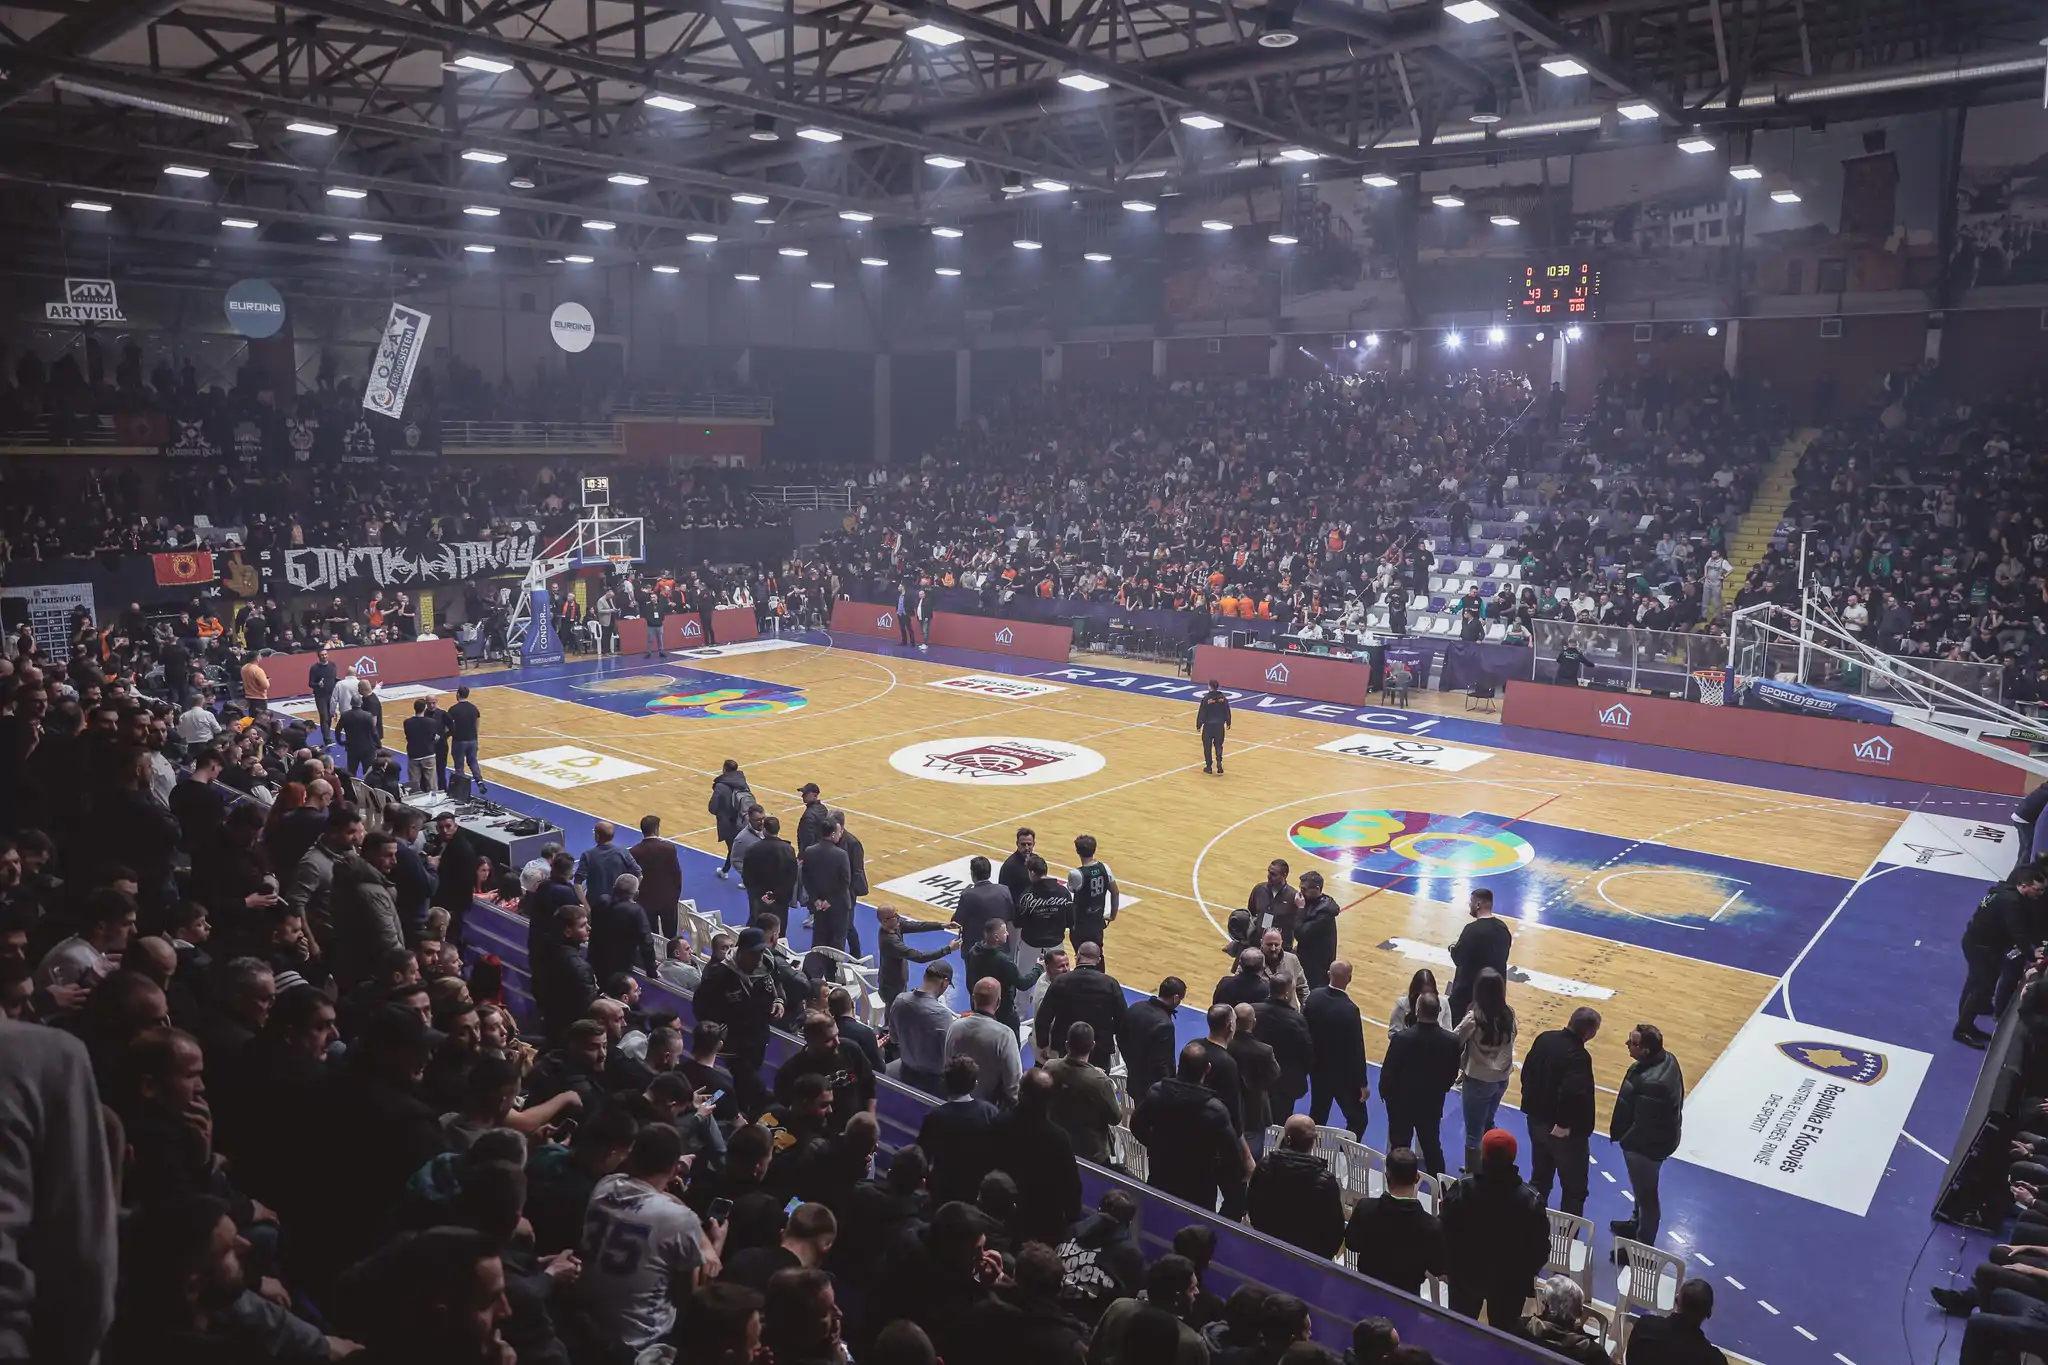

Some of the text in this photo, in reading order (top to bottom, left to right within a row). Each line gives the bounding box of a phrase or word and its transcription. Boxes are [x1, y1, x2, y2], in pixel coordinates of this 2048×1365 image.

[539, 612, 548, 650] CONDOR
[942, 680, 1030, 696] BIGI
[1047, 668, 1440, 731] RAHOVECI
[1759, 685, 1838, 709] SPORTSYSTEM
[1972, 825, 2006, 844] ART
[1791, 1077, 1816, 1108] MINISTRIA
[1749, 1093, 1783, 1133] DHE SPORTIT
[1780, 1083, 1846, 1174] Republika E Kosovës
[1753, 1140, 1778, 1166] RINISË
